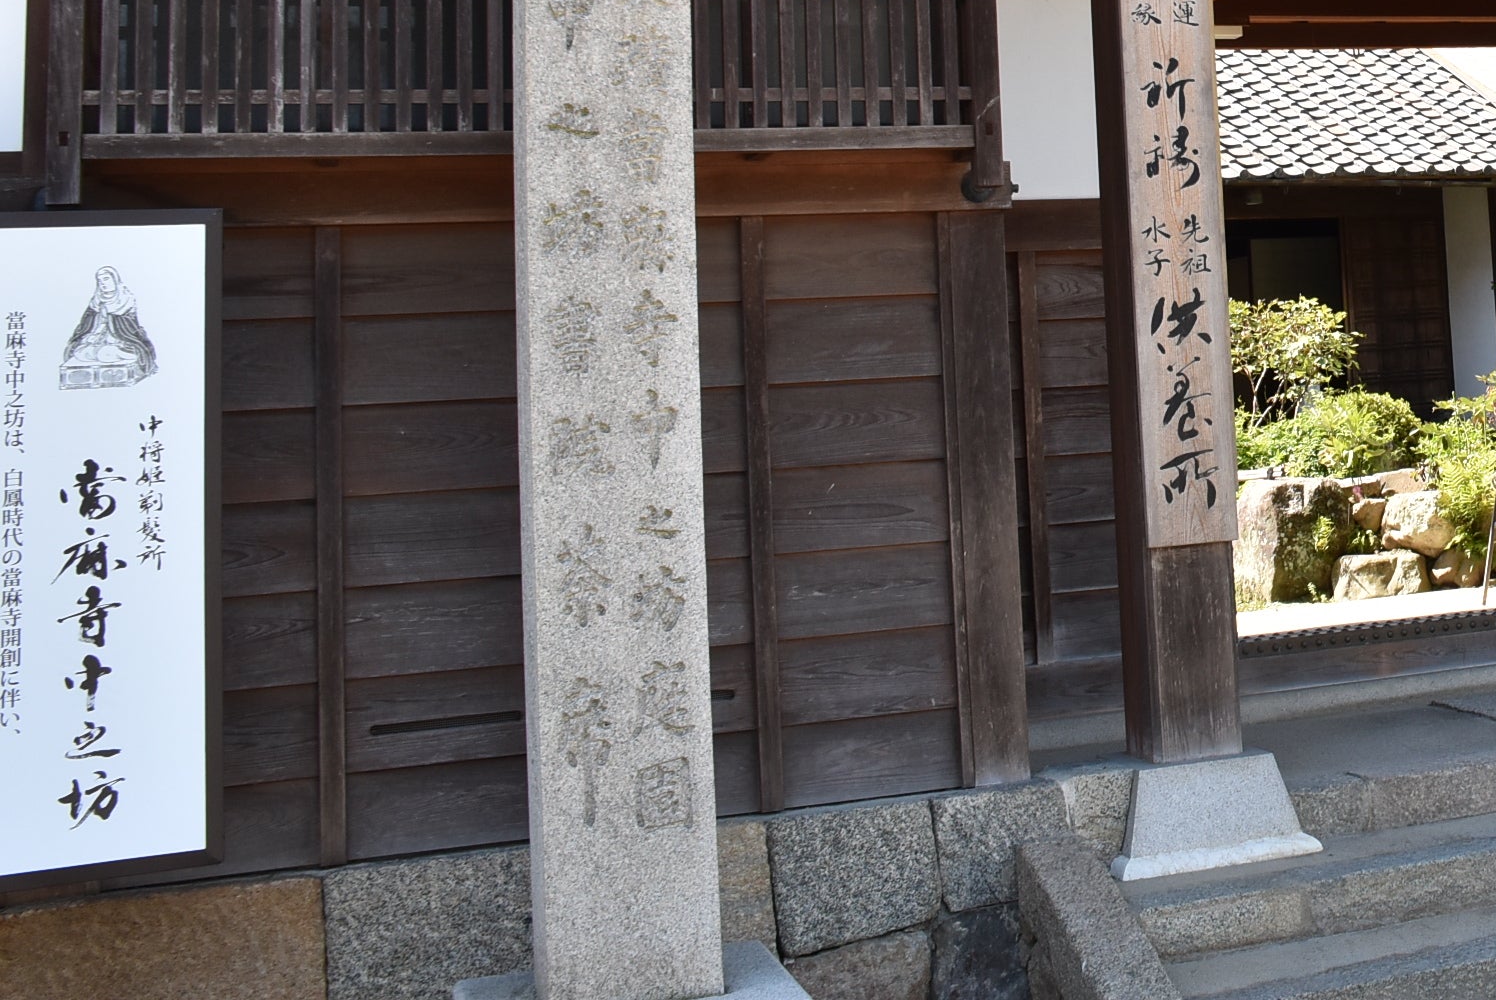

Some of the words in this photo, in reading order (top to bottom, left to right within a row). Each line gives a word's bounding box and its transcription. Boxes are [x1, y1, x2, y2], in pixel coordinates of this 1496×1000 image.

[1141, 215, 1172, 277] 水子
[1180, 214, 1212, 276] 先祖
[1150, 294, 1219, 510] 供養所
[51, 458, 127, 831] 當麻寺中之坊
